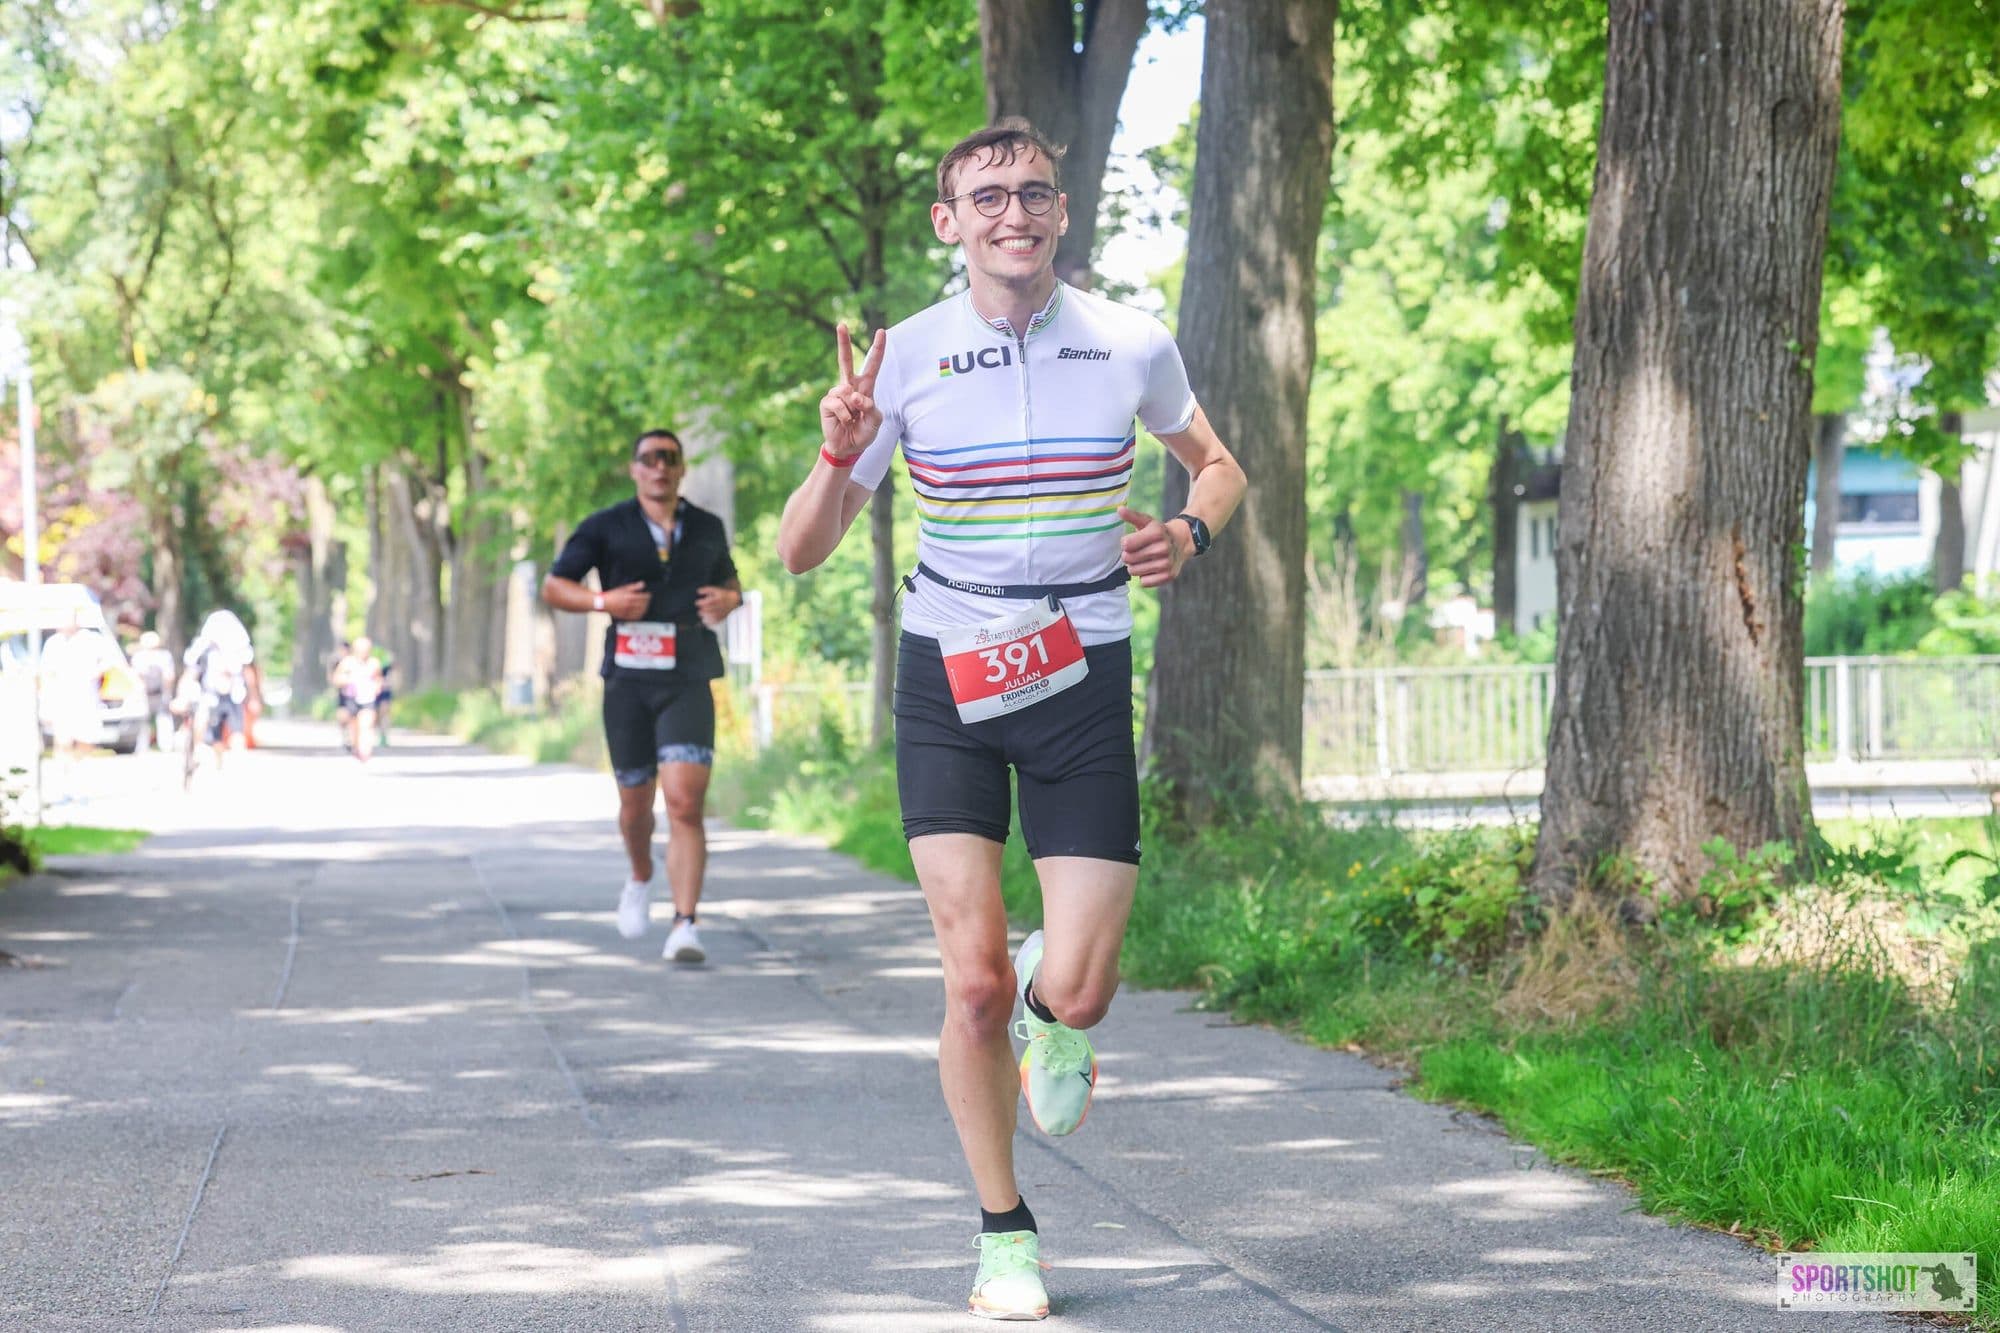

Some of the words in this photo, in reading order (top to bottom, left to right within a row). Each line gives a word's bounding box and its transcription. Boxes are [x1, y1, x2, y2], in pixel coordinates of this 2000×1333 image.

[952, 346, 1012, 374] UCI
[1057, 347, 1112, 361] Santini
[978, 634, 1050, 684] 391
[1004, 669, 1042, 691] JULIAN
[1001, 682, 1041, 702] ERDINGER
